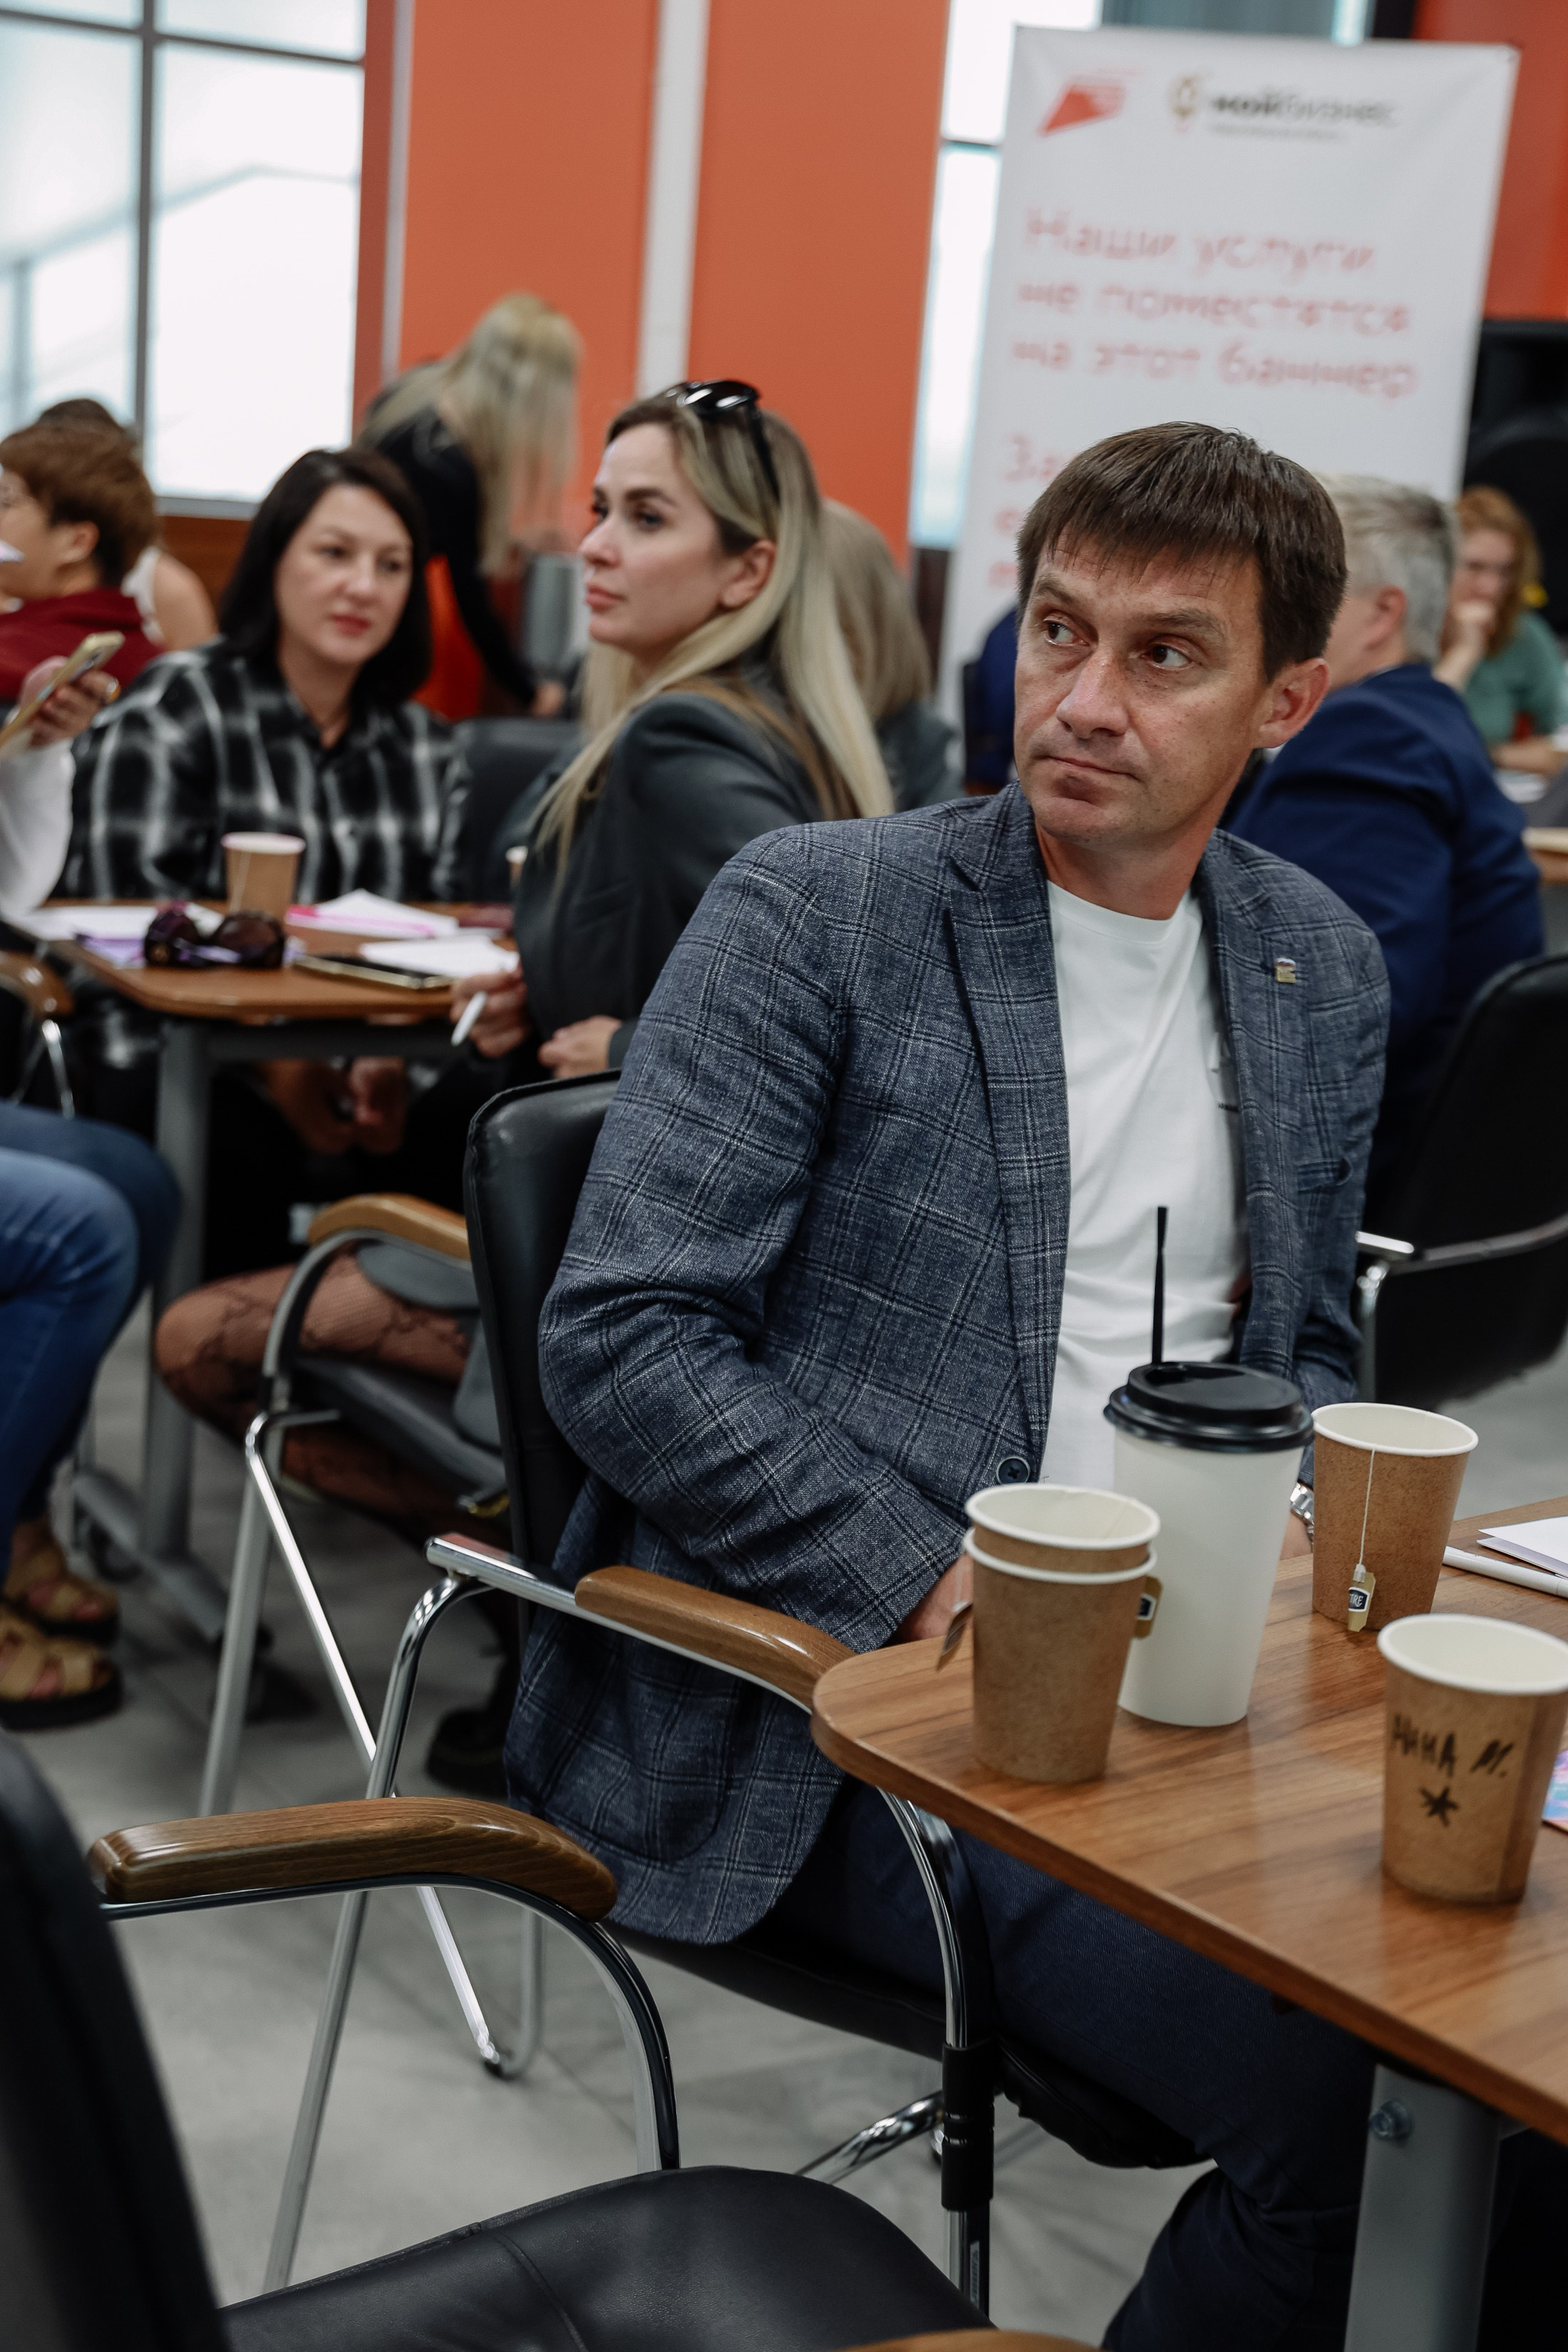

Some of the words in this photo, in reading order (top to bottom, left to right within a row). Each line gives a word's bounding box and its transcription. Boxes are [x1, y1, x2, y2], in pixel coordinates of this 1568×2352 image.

[1024, 207, 1177, 259] Наши
[1195, 233, 1375, 282] услуги
[1017, 282, 1078, 314] не
[1098, 284, 1410, 335] поместятся
[1011, 340, 1071, 371] на
[1093, 340, 1201, 380] этот
[1217, 338, 1419, 405] баннер
